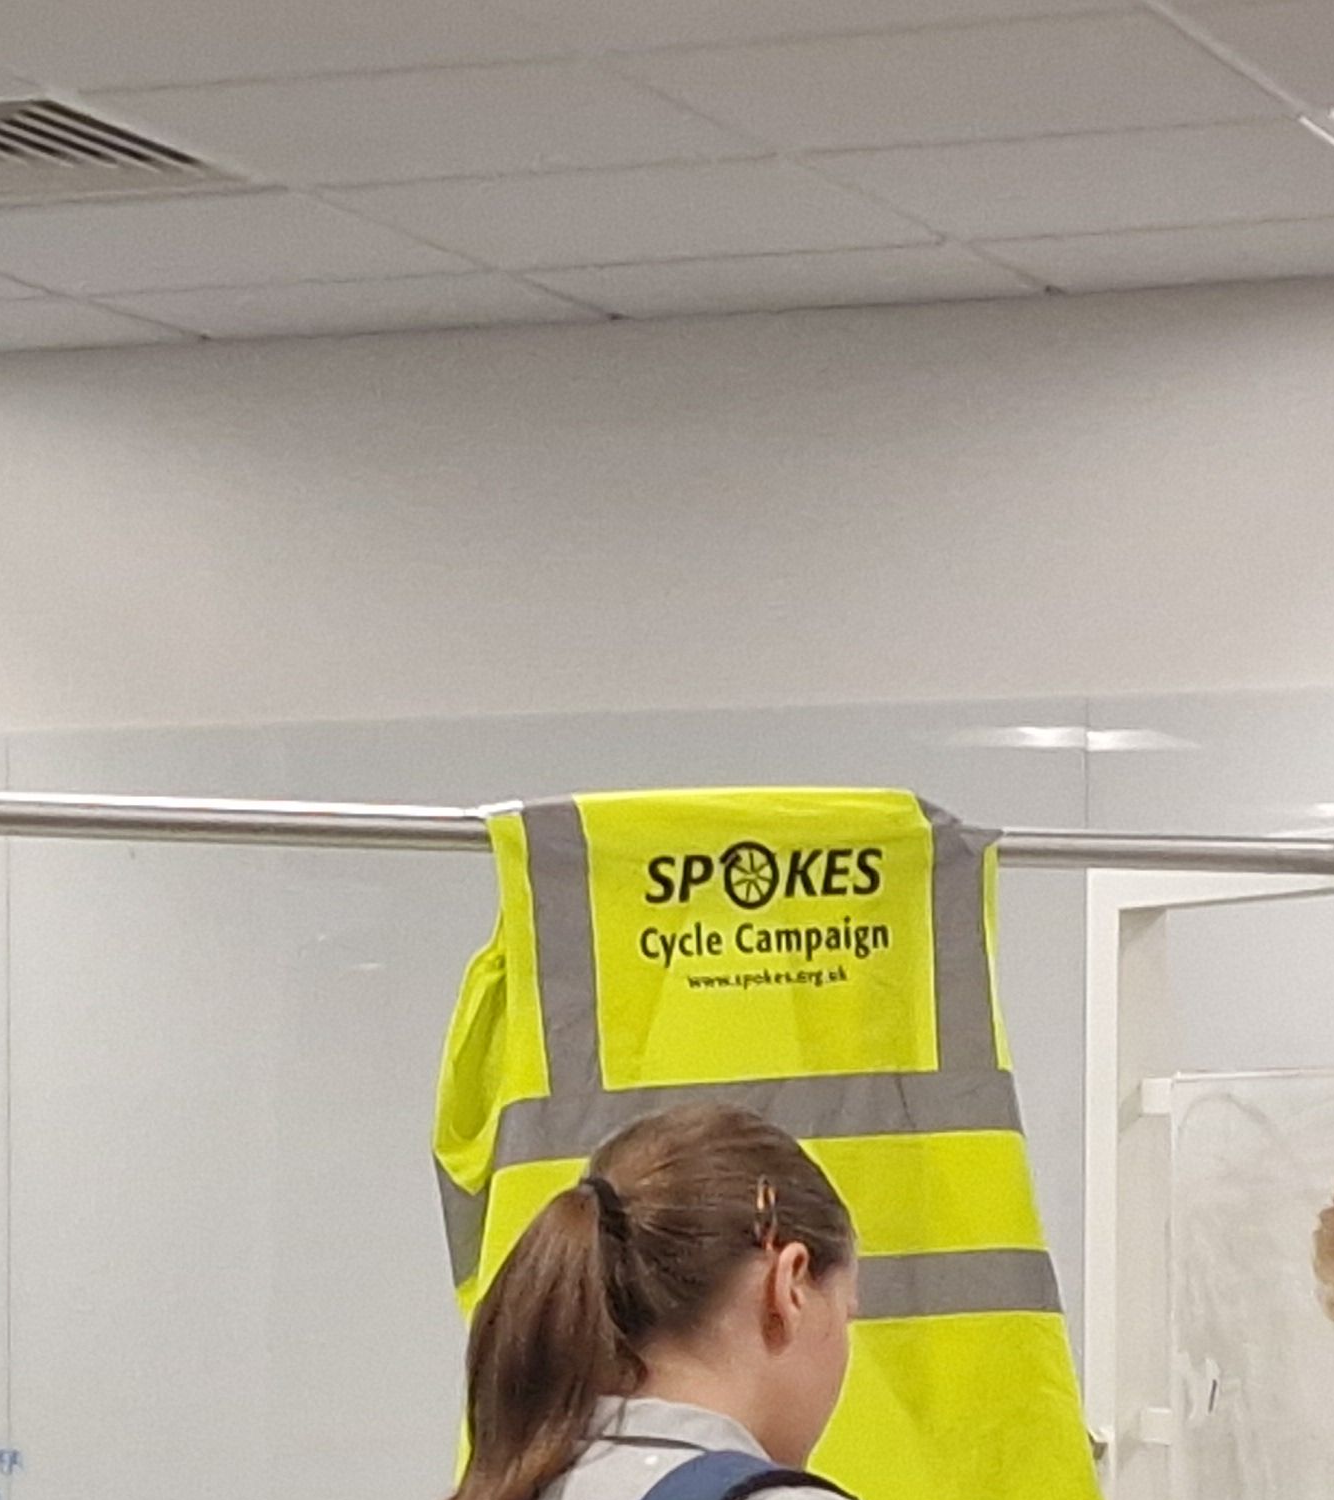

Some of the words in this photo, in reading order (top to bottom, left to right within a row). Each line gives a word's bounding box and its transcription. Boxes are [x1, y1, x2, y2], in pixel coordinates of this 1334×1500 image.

[644, 841, 883, 910] SPOKES
[640, 923, 722, 968] Cycle
[735, 916, 889, 960] Campaign
